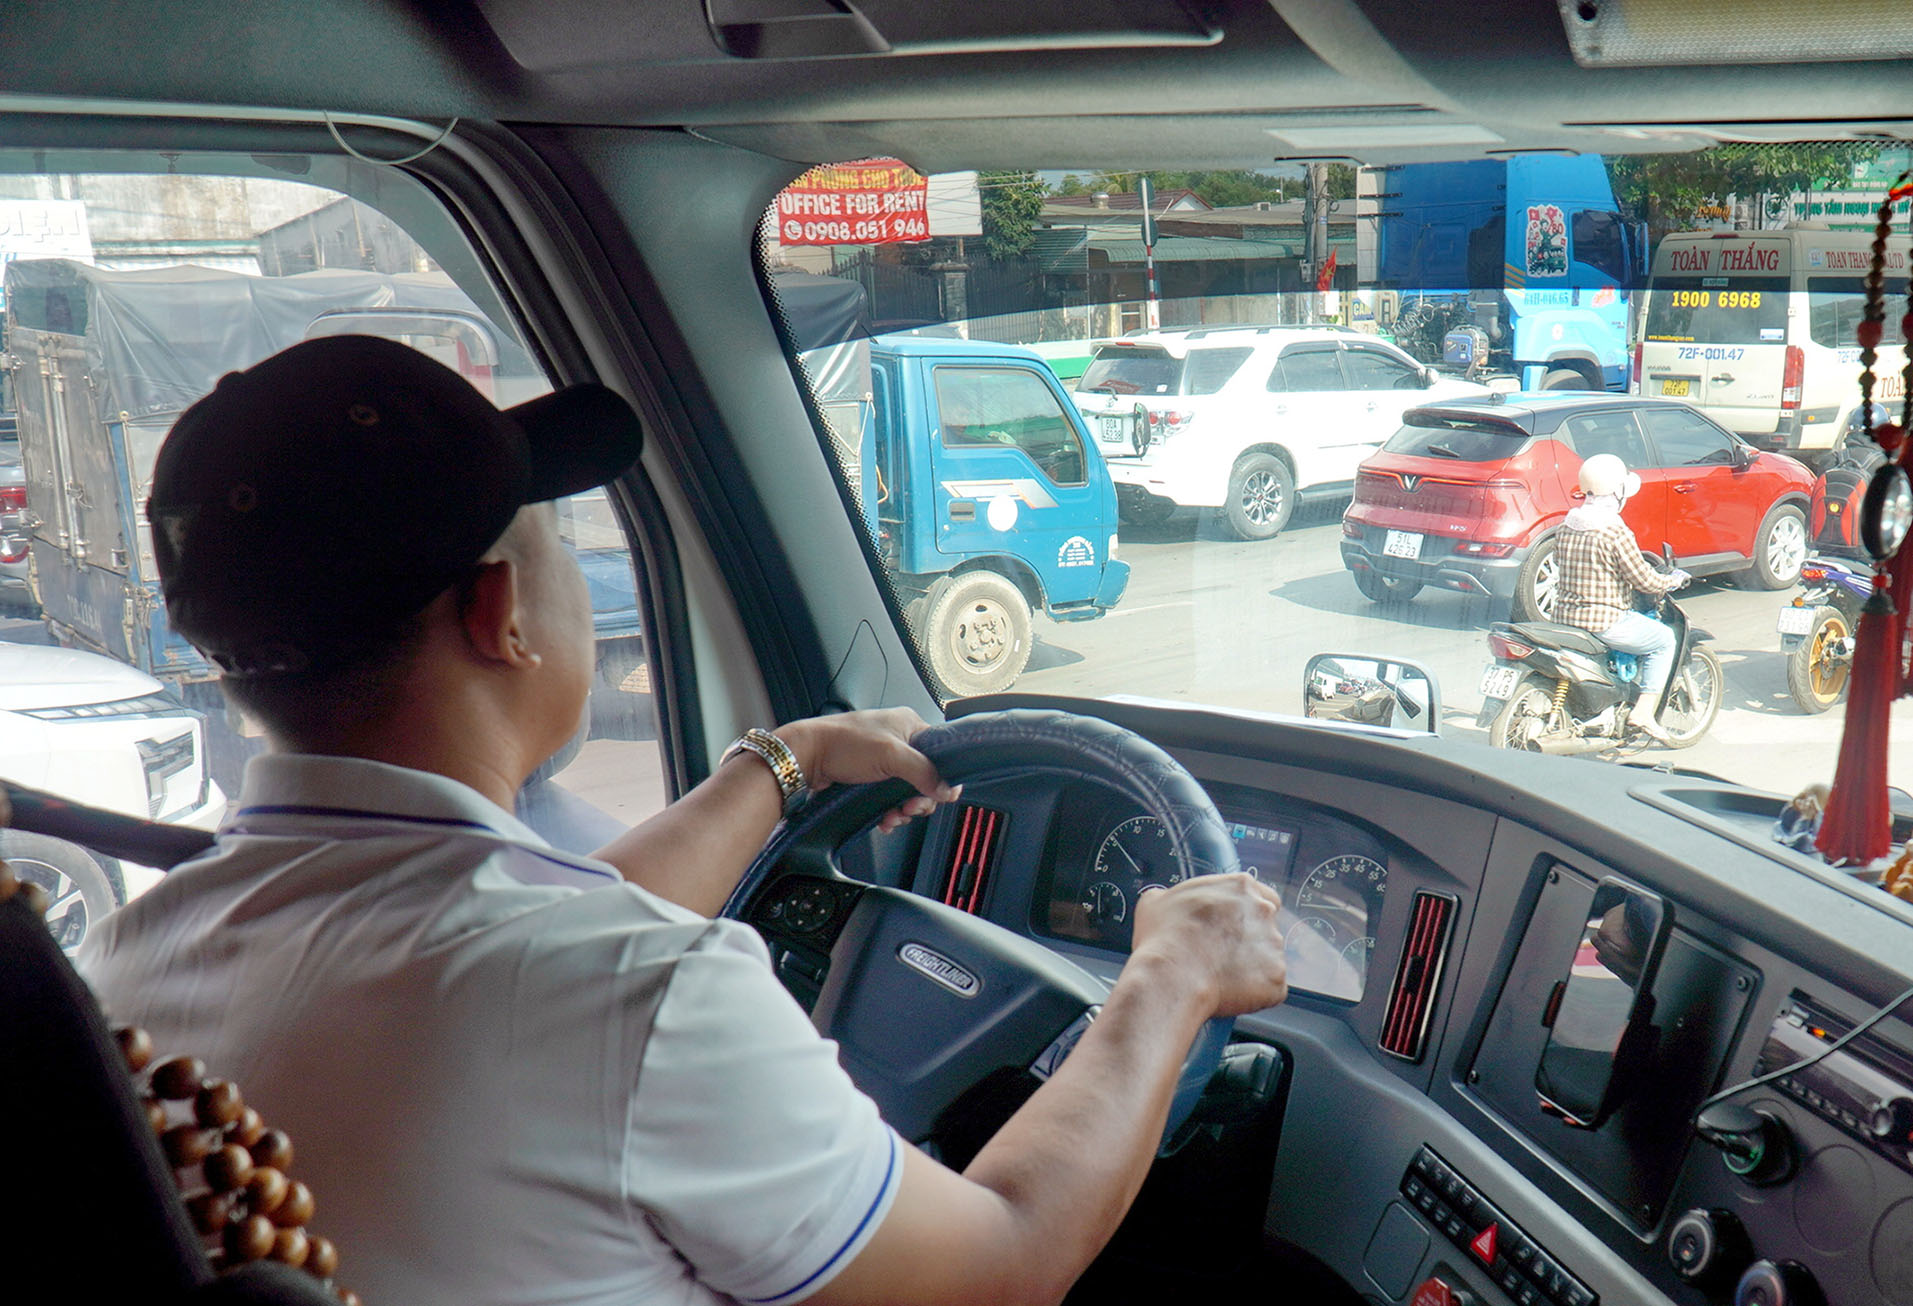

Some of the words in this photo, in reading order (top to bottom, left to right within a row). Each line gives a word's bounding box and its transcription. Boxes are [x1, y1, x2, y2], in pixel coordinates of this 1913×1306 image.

[782, 193, 842, 215] OFFICE
[846, 192, 879, 214] FOR
[884, 190, 925, 213] RENT
[894, 217, 925, 237] 946
[1671, 245, 1711, 271] TOÀN
[1720, 241, 1780, 271] THẮNG
[1672, 291, 1710, 307] 1900
[1718, 291, 1761, 308] 6968
[905, 947, 973, 989] FREIGHTLINER
